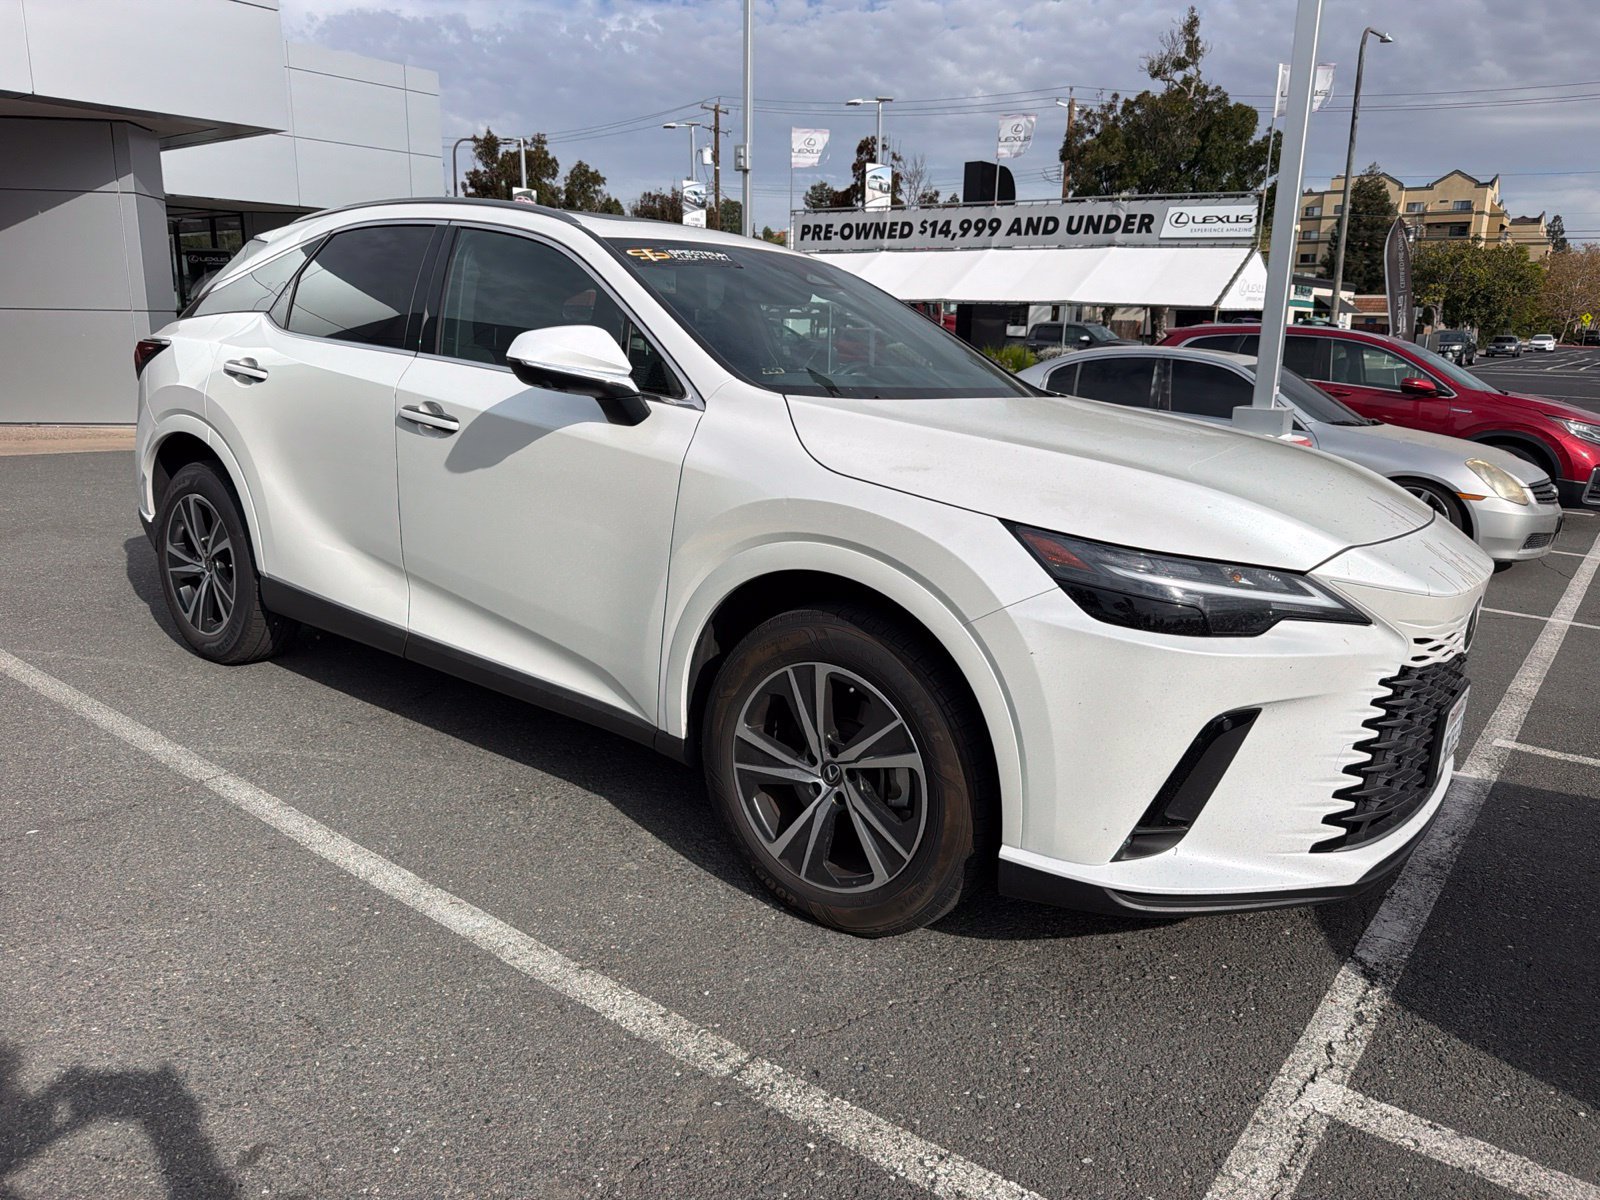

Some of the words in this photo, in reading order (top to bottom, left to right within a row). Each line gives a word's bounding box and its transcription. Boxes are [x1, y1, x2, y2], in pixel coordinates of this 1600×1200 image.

[800, 222, 914, 241] PRE-OWNED
[918, 217, 1002, 240] $14,999
[1005, 216, 1060, 236] AND
[1066, 213, 1155, 235] UNDER
[1192, 214, 1253, 224] LEXUS
[1396, 295, 1404, 335] LEXUS
